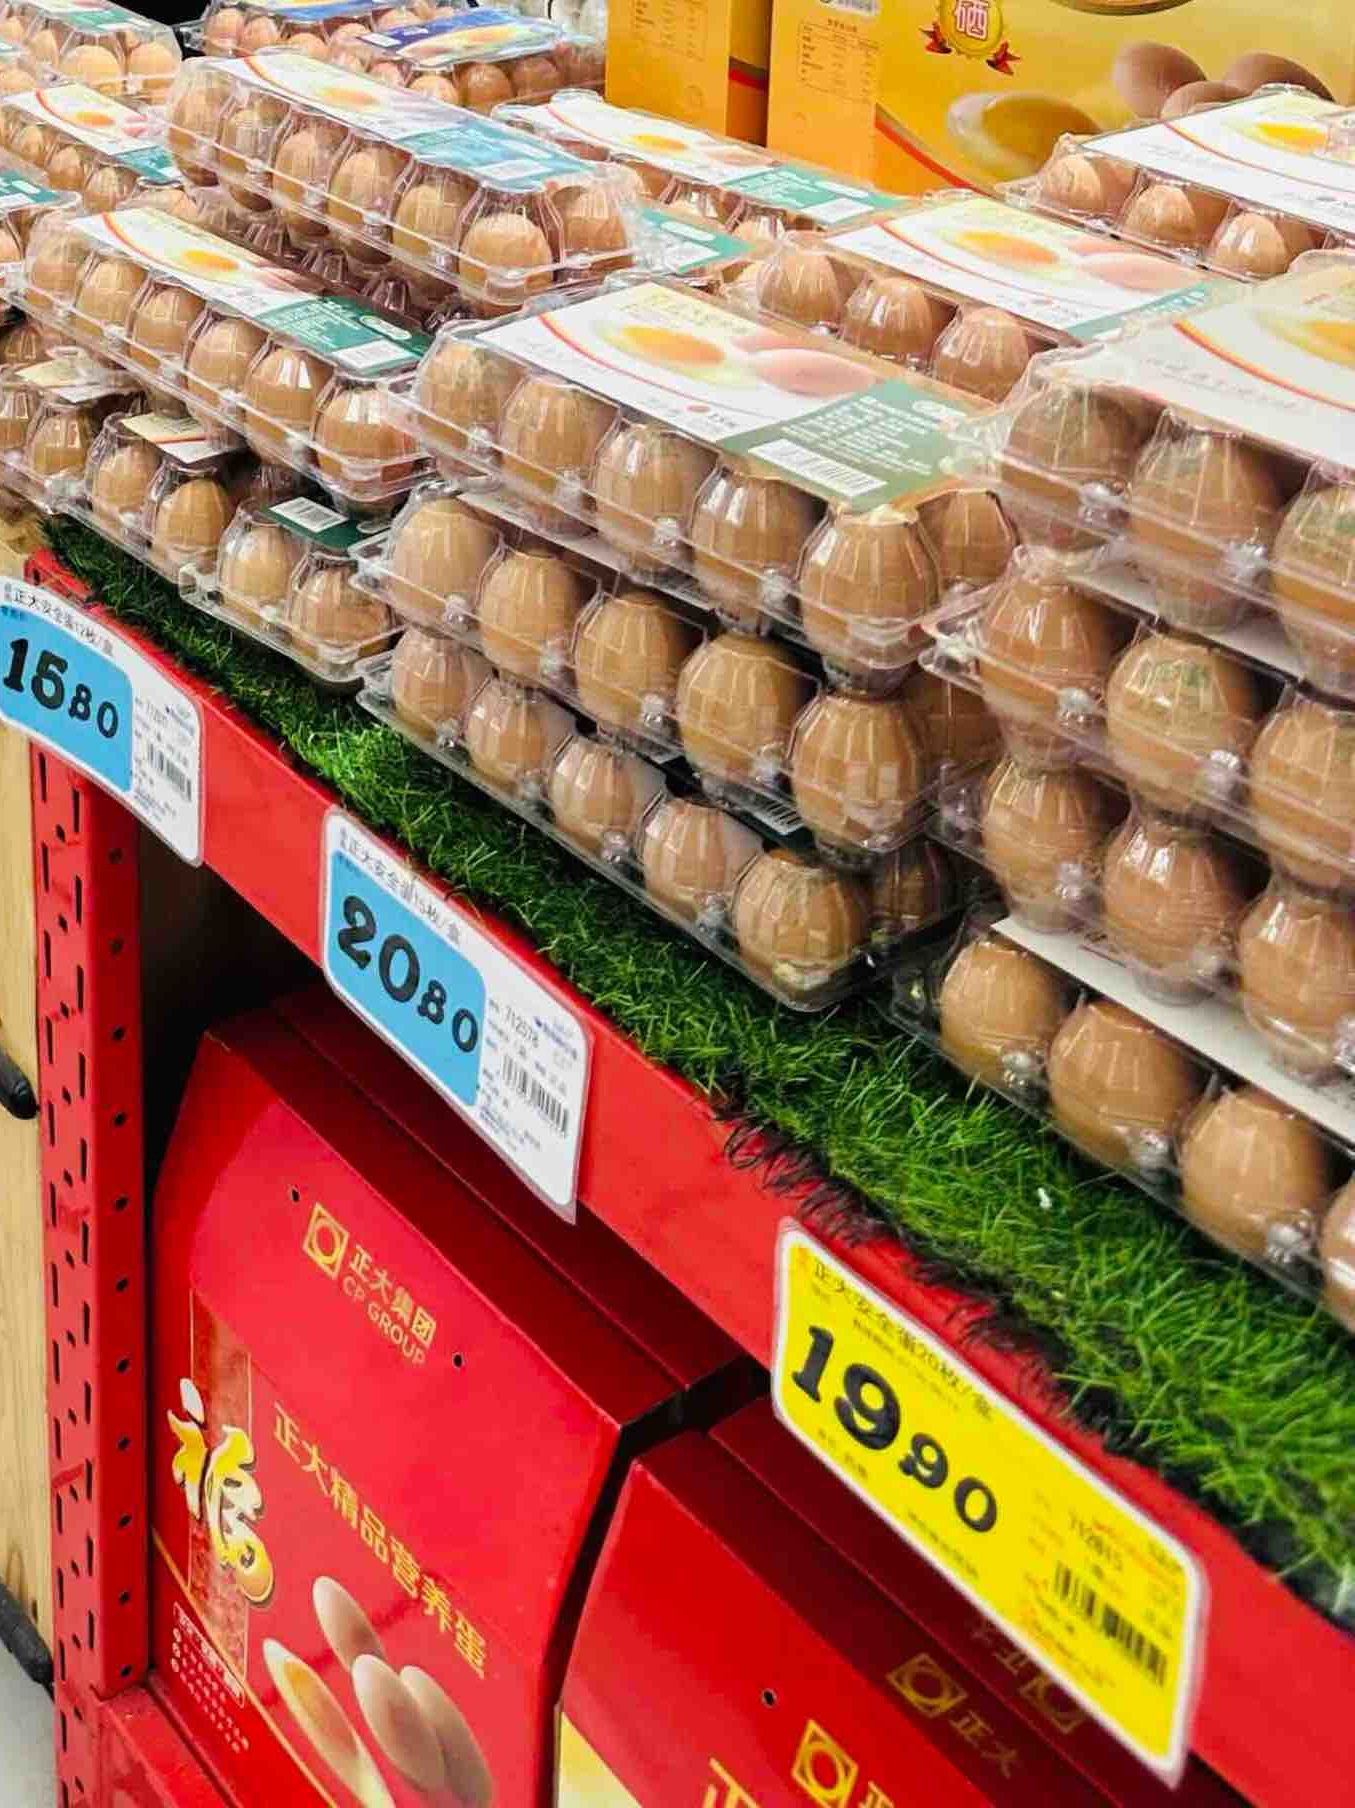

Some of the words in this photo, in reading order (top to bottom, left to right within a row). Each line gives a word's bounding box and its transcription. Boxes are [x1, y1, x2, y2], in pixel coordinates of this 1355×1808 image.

[342, 1275, 367, 1302] CP
[367, 1300, 427, 1365] GROUP
[350, 1244, 437, 1349] 正大集团
